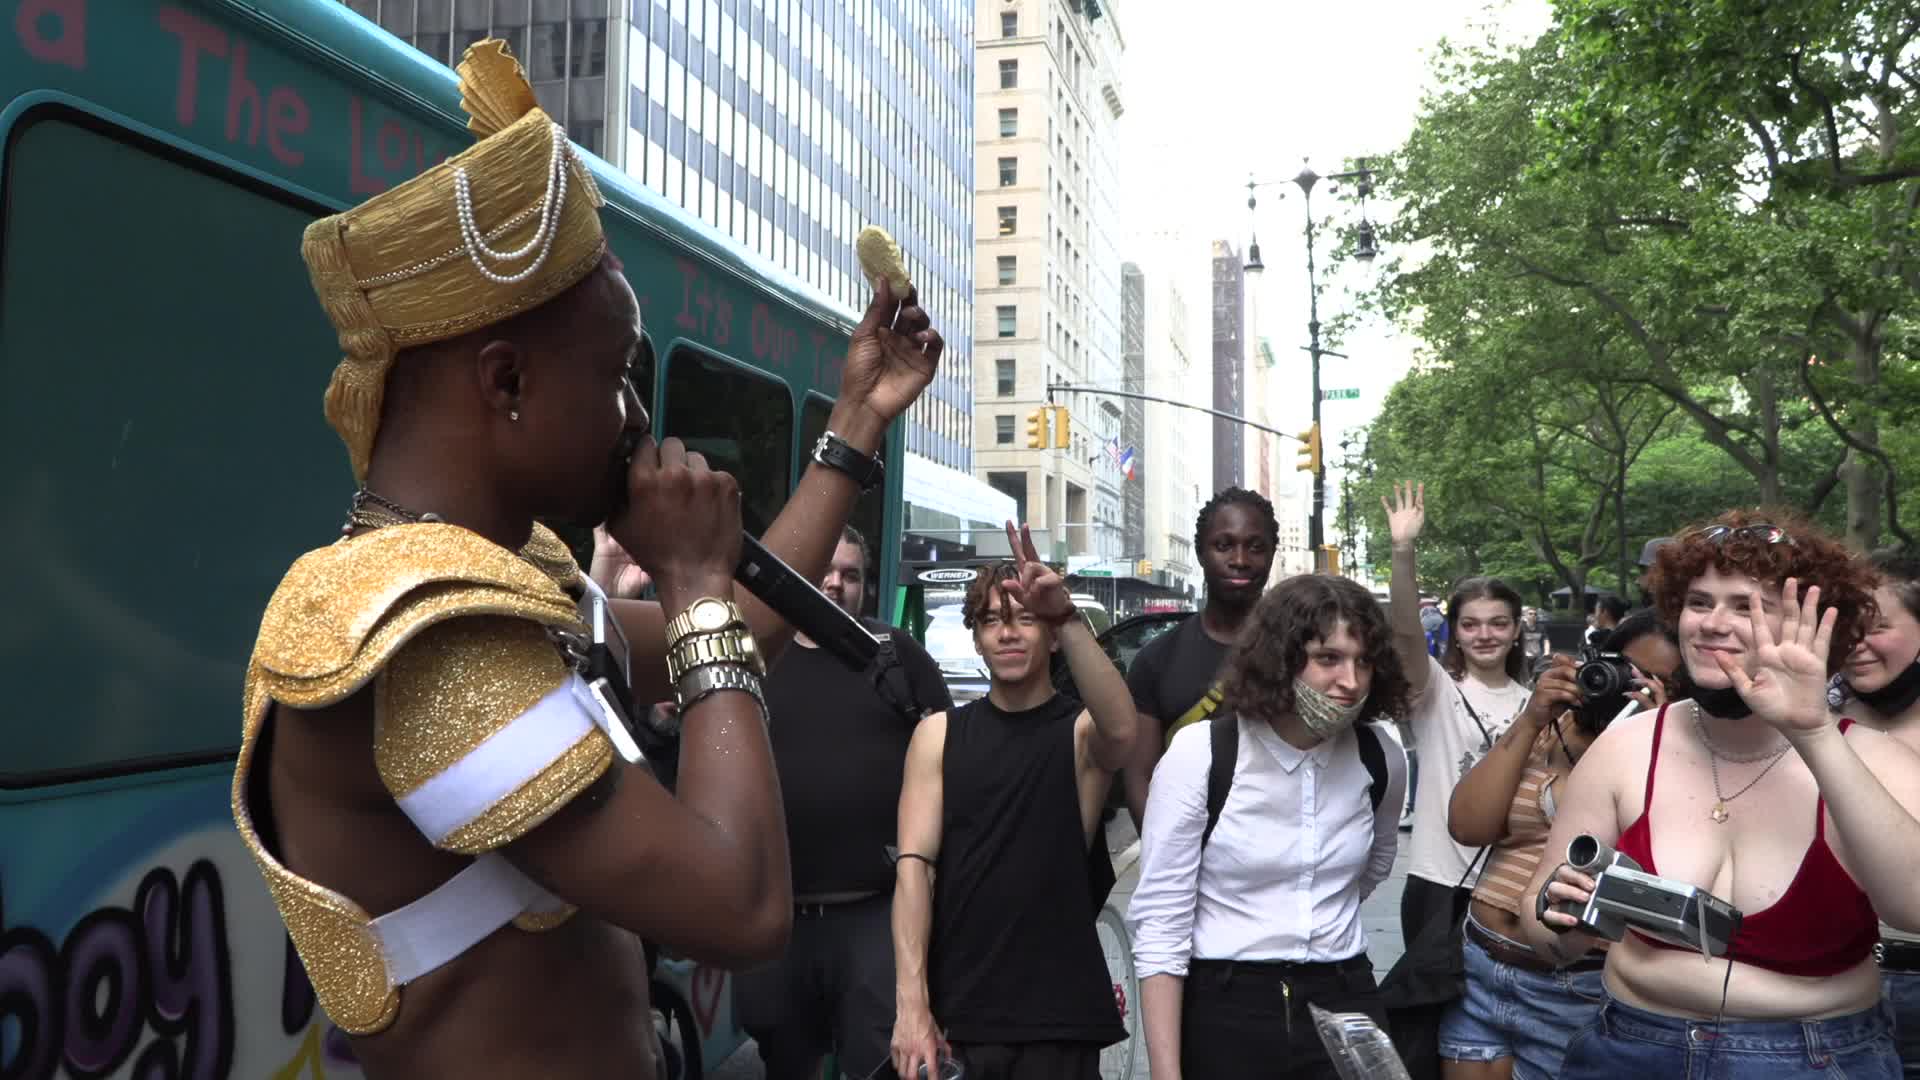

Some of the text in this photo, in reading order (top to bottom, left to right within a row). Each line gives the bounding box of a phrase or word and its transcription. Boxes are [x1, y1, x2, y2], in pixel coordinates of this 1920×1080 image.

[159, 7, 309, 167] The
[751, 302, 798, 370] Our
[930, 571, 969, 581] WERNER
